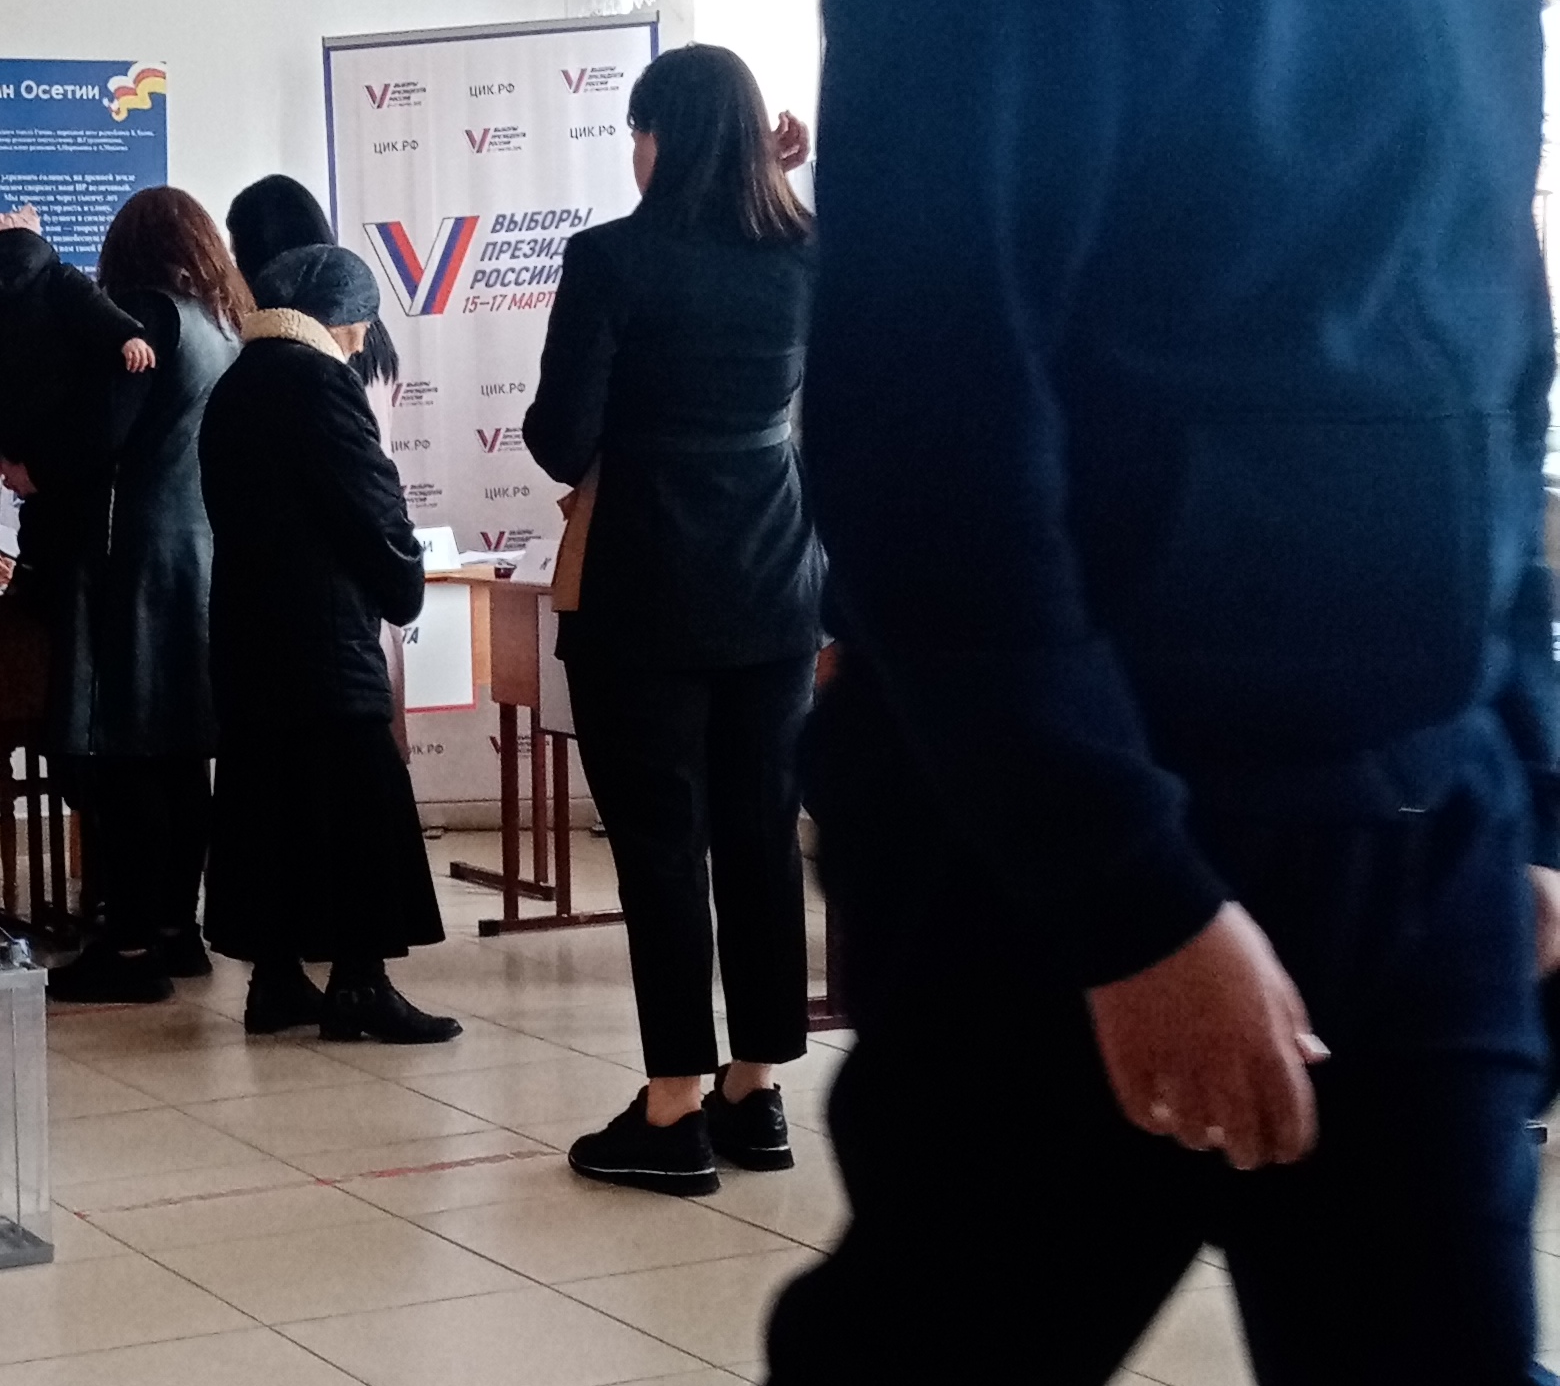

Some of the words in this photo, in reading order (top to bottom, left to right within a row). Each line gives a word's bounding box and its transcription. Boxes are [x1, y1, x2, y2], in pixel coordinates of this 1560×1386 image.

[20, 79, 101, 100] Осетии
[469, 83, 515, 98] ЦИК.РФ
[569, 125, 616, 140] ЦИК.РФ
[373, 140, 419, 154] ЦИК.РФ
[490, 207, 593, 234] ВЫБОРЫ
[469, 264, 563, 290] РОССИИ
[481, 382, 527, 397] ЦИК.РФ
[485, 485, 530, 501] ЦИК.РФ
